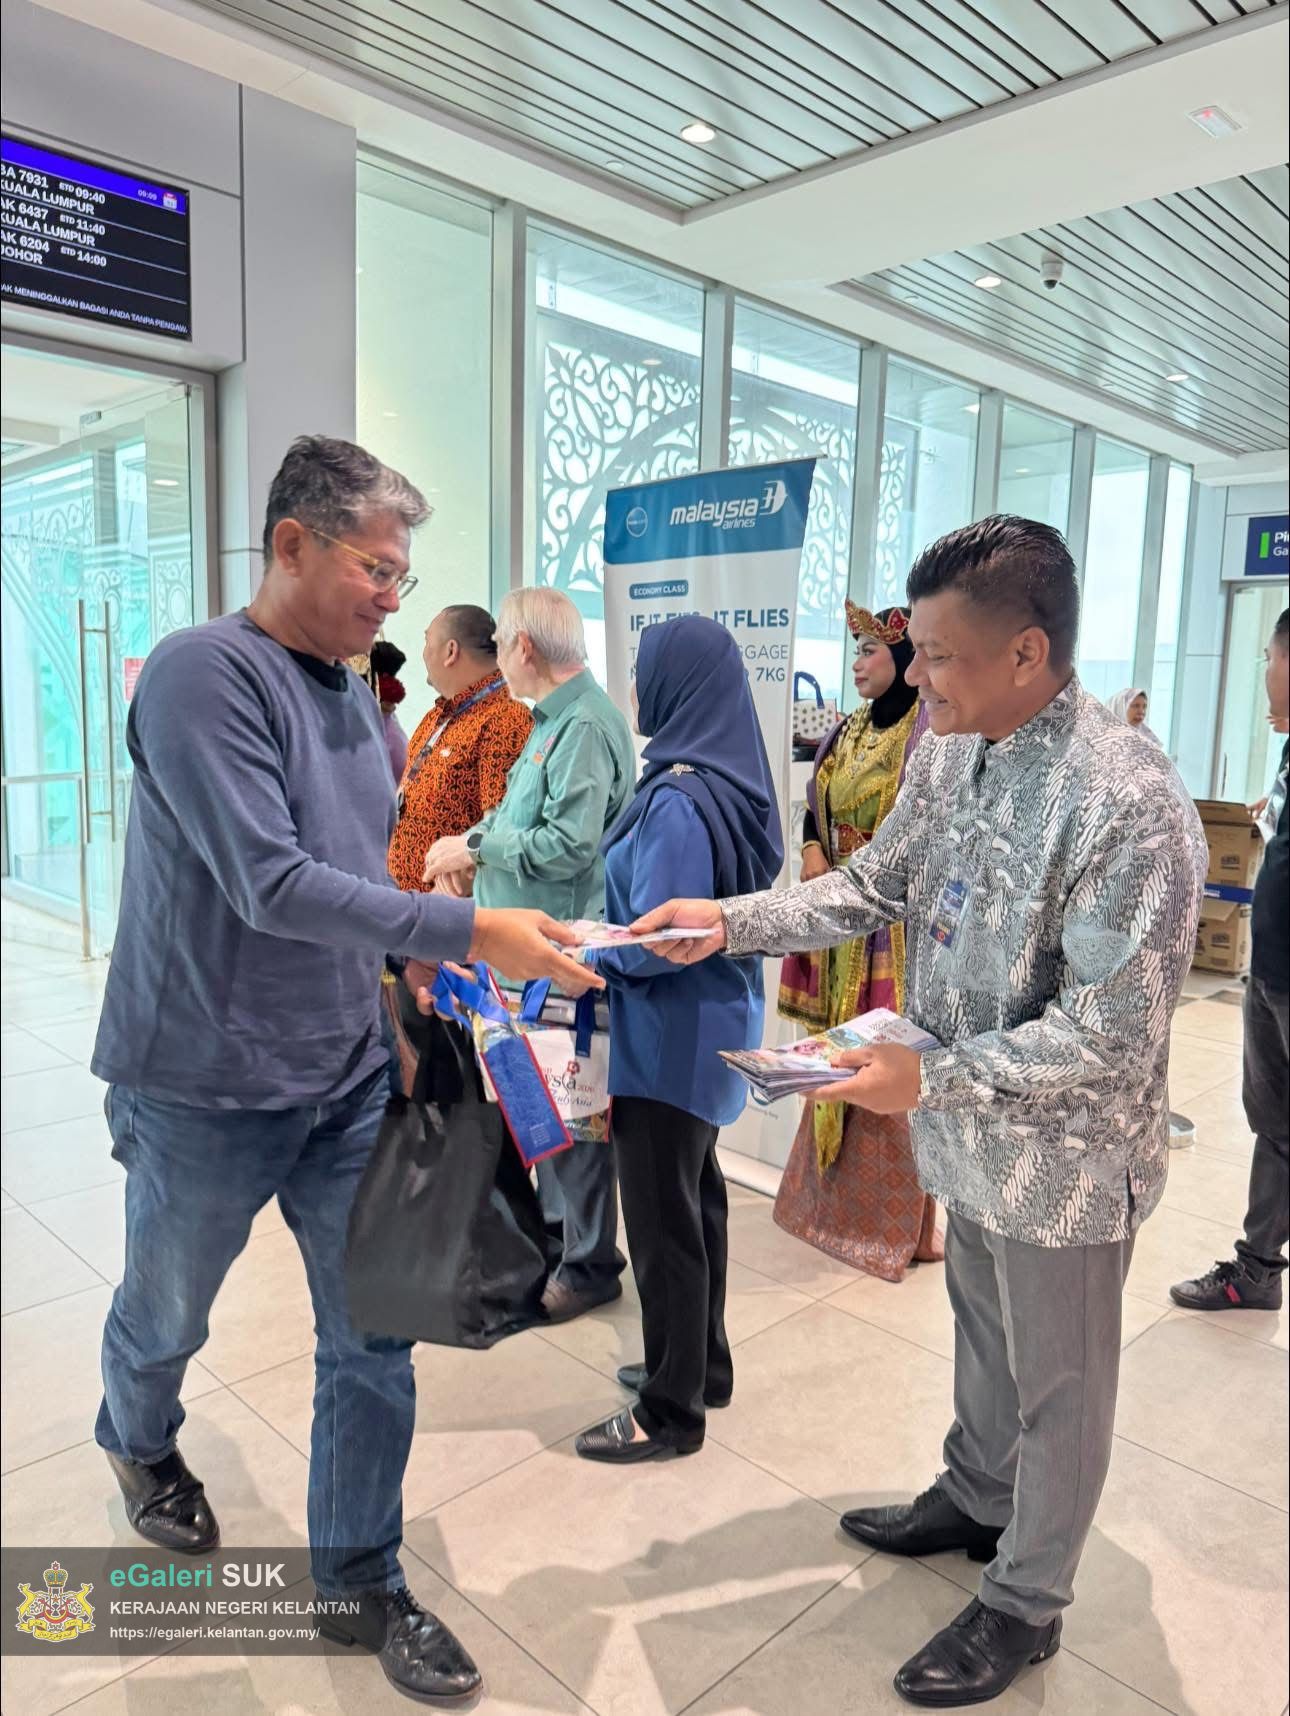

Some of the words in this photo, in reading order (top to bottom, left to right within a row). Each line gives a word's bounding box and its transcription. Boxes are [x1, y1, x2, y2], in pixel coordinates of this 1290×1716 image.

[19, 169, 49, 189] 7931
[59, 182, 75, 193] ETD
[75, 187, 106, 205] 09:40
[42, 190, 95, 215] LUMPUR
[18, 202, 49, 220] 6437
[60, 214, 76, 225] ETD
[76, 219, 106, 236] 11:40
[43, 223, 96, 247] LUMPUR
[20, 235, 50, 253] 6204
[60, 246, 77, 257] ETD
[77, 250, 107, 267] 14:00
[1, 283, 13, 293] AK
[14, 286, 79, 309] MENINGGALKAN
[79, 301, 108, 315] BAGASI
[109, 307, 131, 321] ANDA
[155, 318, 188, 334] PENGAW
[669, 498, 759, 528] malaysia
[722, 517, 756, 530] airlines
[1274, 531, 1289, 544] Pi
[633, 586, 662, 596] ECONOMY
[663, 584, 686, 594] CLASS
[630, 614, 645, 632] IF
[733, 608, 790, 628] FLIES
[737, 644, 789, 660] GAGE
[755, 667, 786, 682] 7KG
